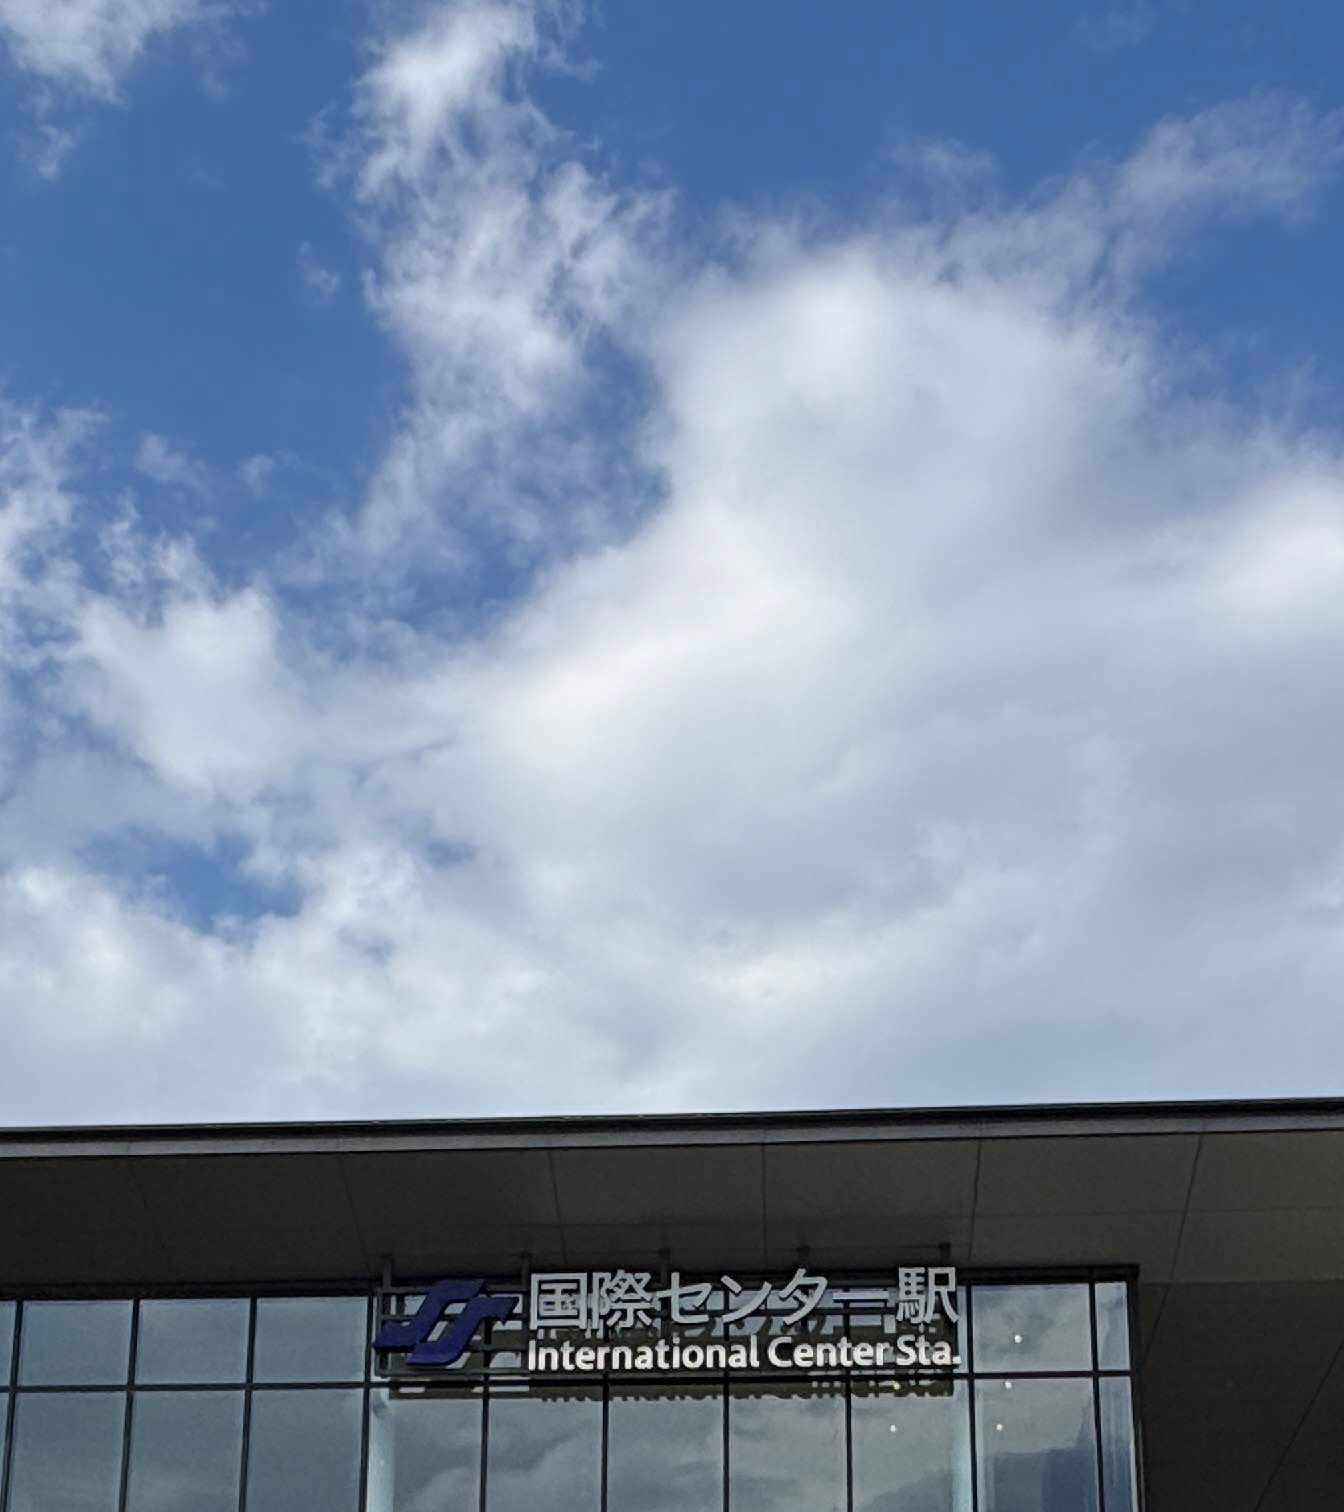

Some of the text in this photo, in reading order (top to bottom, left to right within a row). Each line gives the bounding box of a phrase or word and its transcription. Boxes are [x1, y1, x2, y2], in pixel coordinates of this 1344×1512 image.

[530, 1267, 960, 1330] 国際センター駅
[528, 1334, 961, 1371] International Center Sta.
